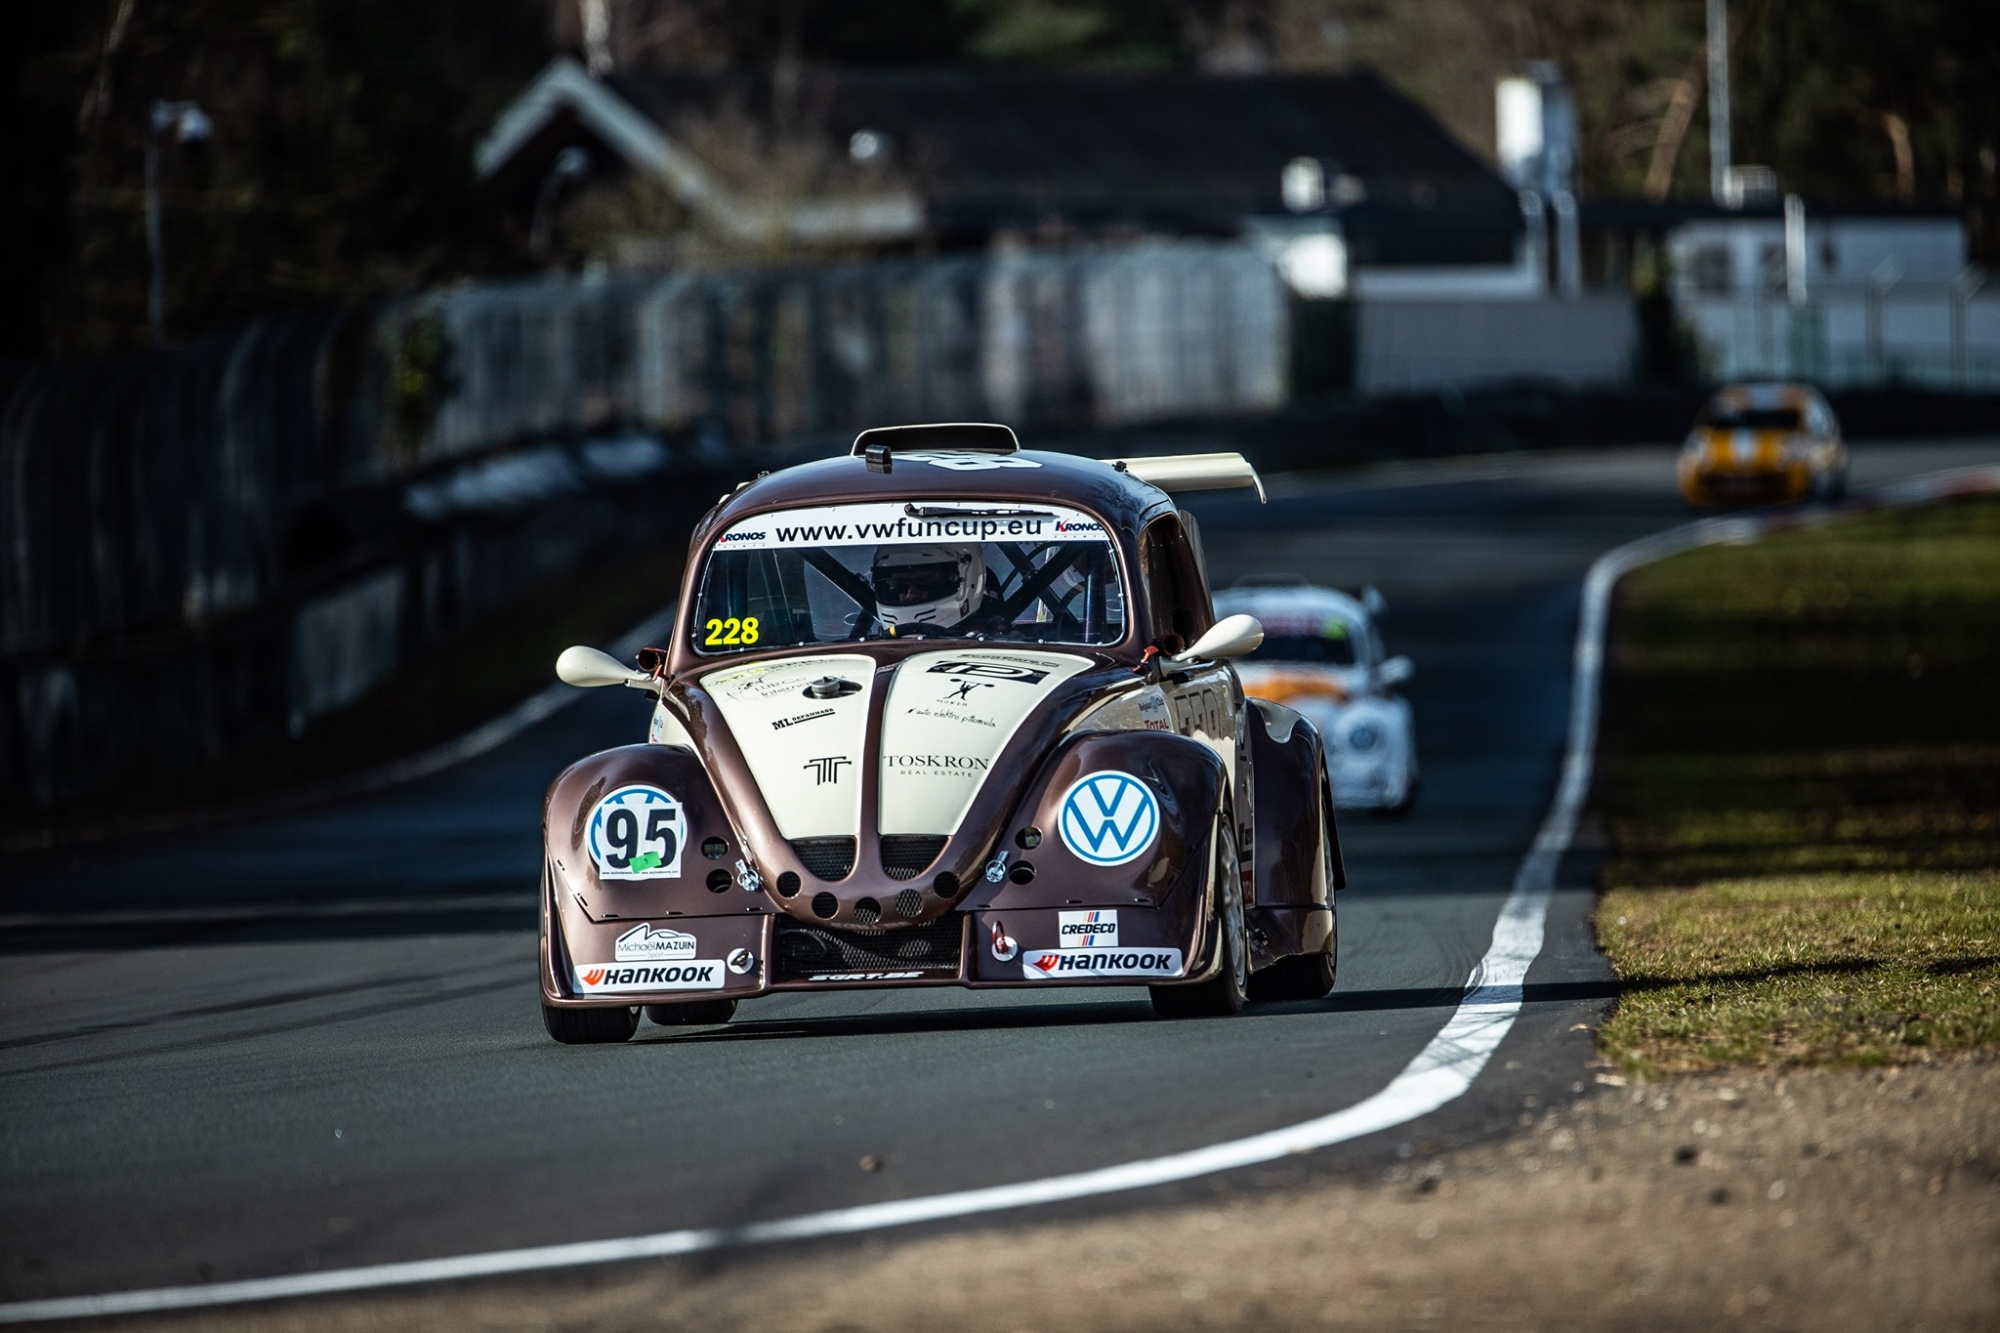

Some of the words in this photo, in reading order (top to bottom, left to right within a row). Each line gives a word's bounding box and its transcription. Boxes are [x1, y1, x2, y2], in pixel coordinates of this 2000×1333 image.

[776, 517, 1041, 542] www.vwfuncup.eu
[705, 617, 759, 646] 228
[771, 718, 794, 730] ML
[883, 755, 989, 770] TOSKRON
[934, 770, 973, 778] ESTATE
[606, 808, 677, 868] 95
[1061, 923, 1116, 935] CREDECO
